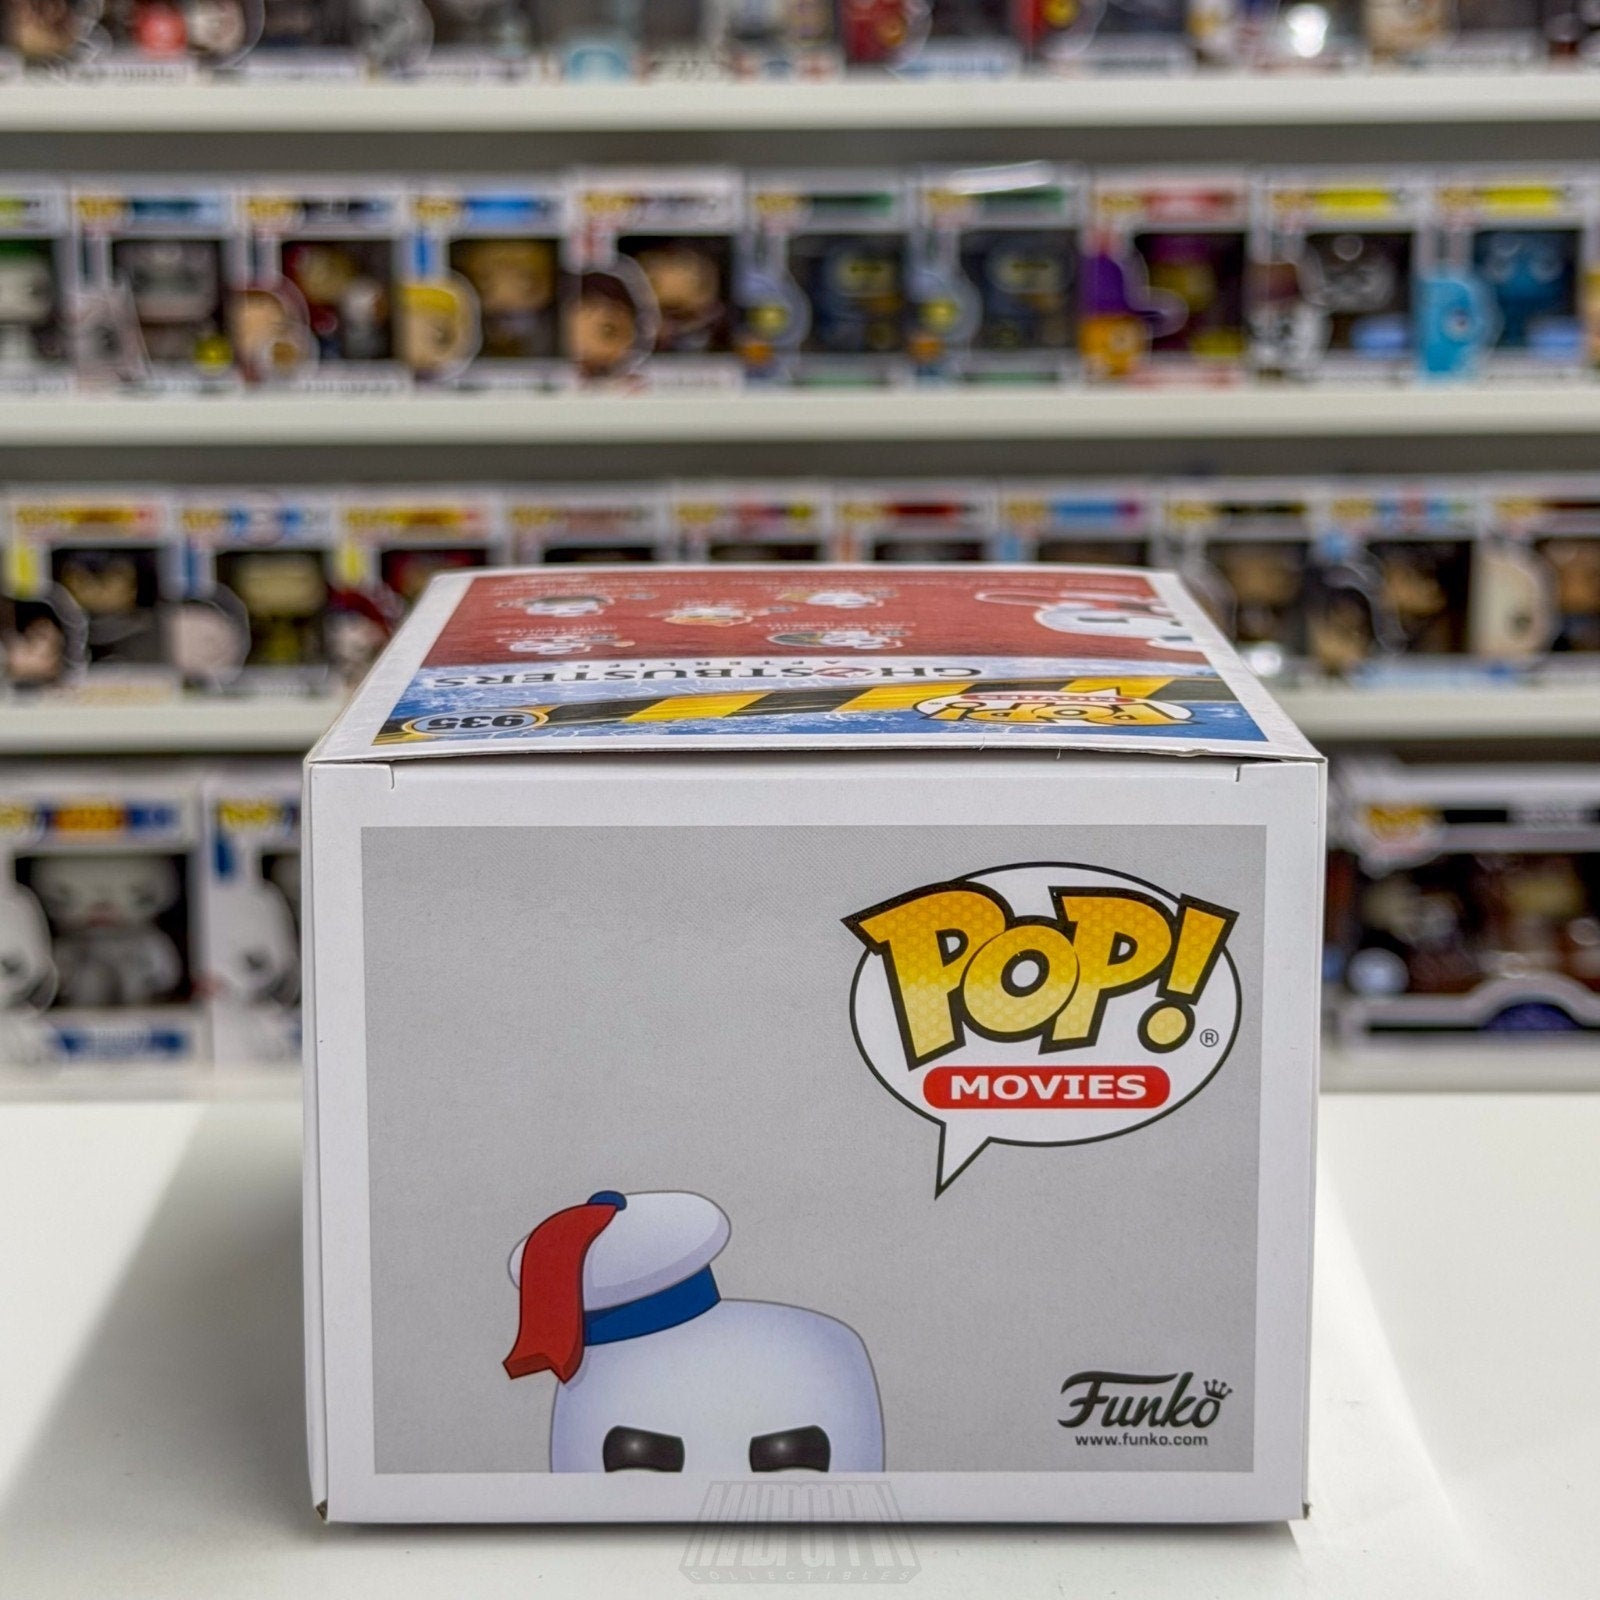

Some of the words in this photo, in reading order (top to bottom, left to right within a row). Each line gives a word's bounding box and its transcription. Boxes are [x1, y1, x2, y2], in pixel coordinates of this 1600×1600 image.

[433, 666, 982, 688] GHOSTBUSTERS
[975, 694, 1117, 703] MOVIES
[427, 714, 525, 732] 935
[919, 700, 1206, 727] POP!
[842, 881, 1240, 1070] POP!
[951, 1074, 1148, 1101] MOVIES
[1057, 1370, 1225, 1428] Funko
[1075, 1432, 1209, 1447] www.funko.com
